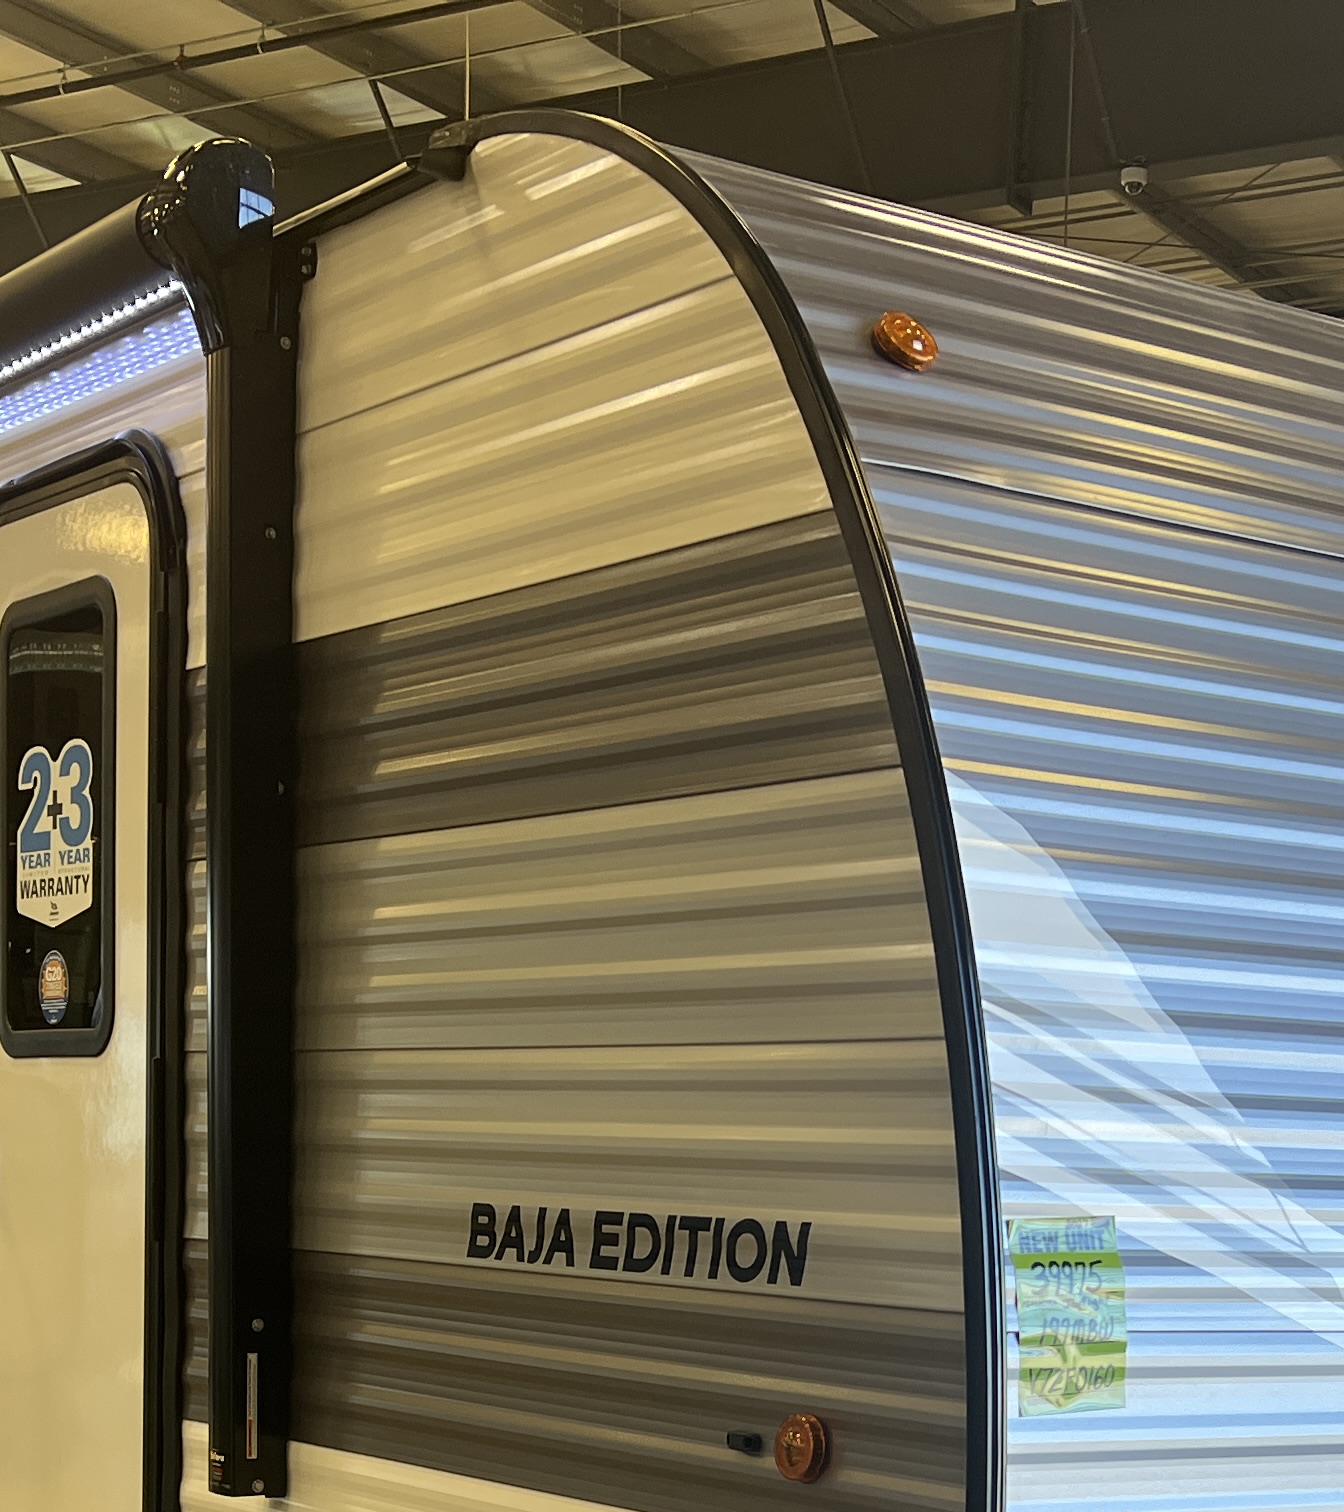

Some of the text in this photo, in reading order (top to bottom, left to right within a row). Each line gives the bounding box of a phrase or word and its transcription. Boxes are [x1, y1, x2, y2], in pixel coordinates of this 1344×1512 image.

[20, 847, 91, 871] YEAR YEAR
[20, 874, 90, 899] WARRANTY
[467, 1202, 812, 1287] BAJA EDITION
[1018, 1228, 1106, 1254] NEW UNIT
[1030, 1259, 1104, 1297] 39975
